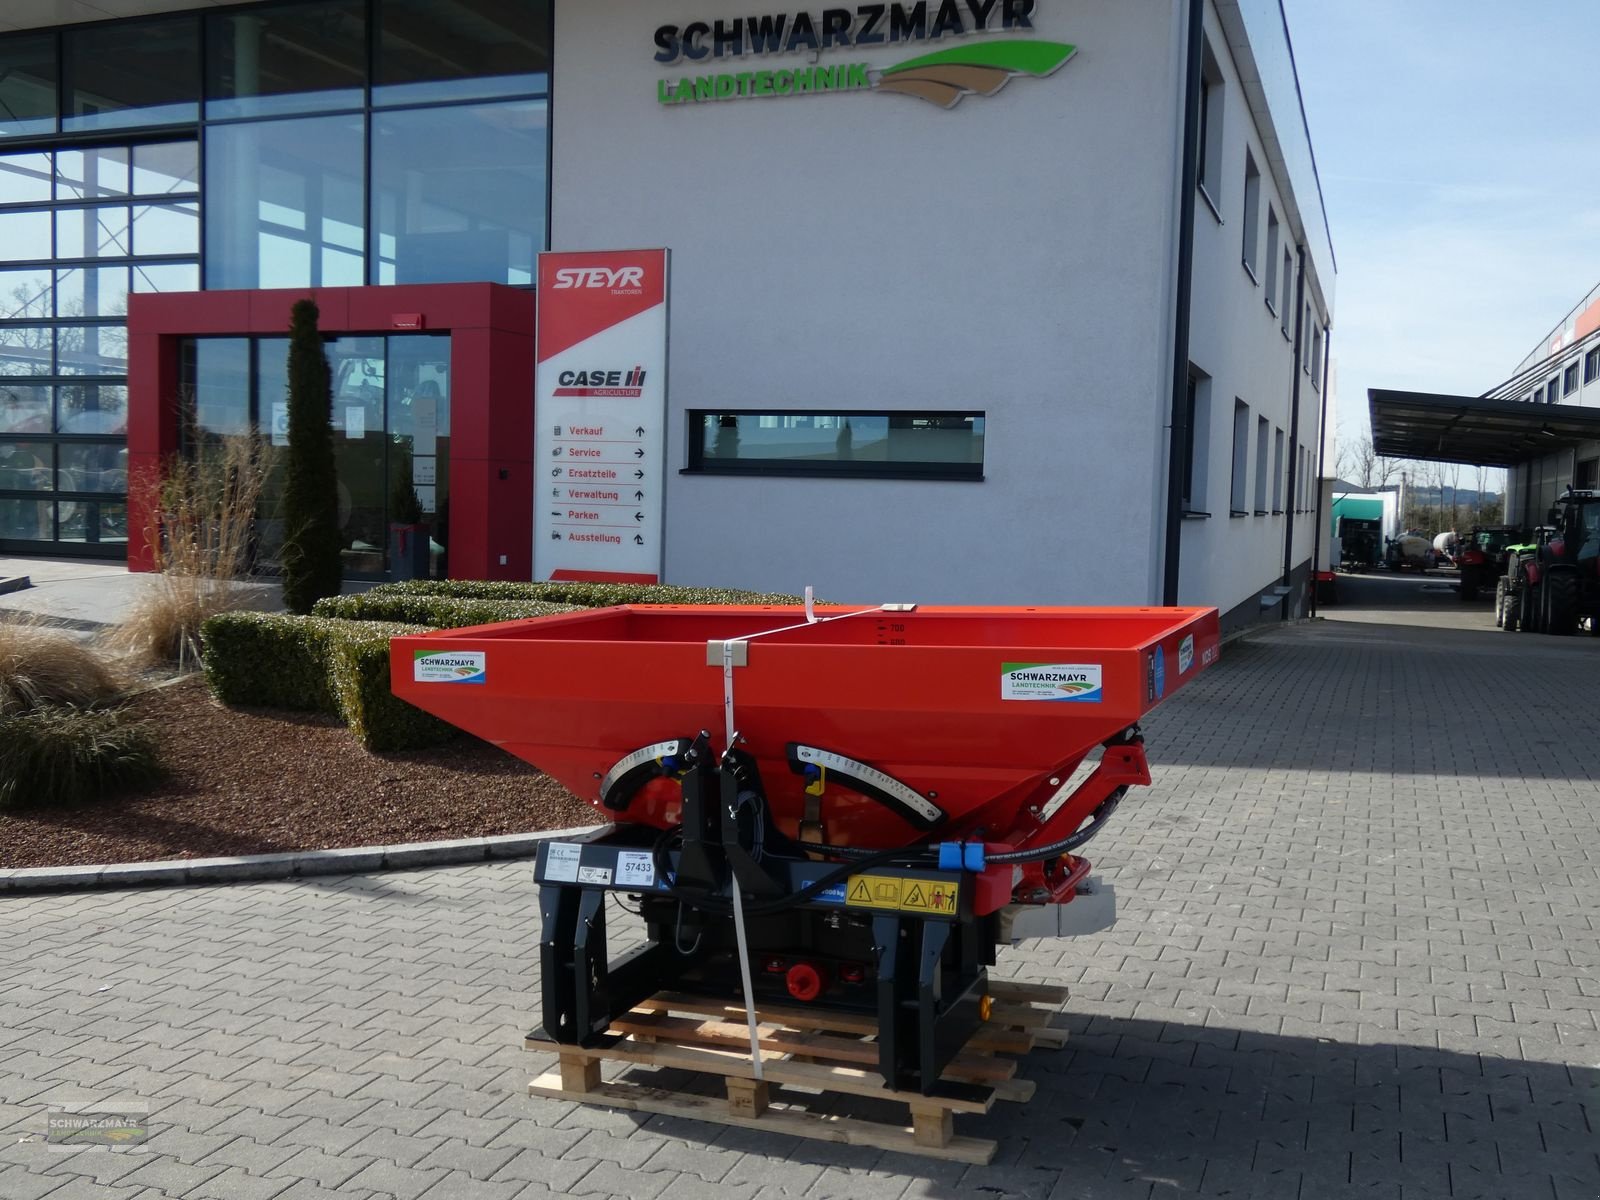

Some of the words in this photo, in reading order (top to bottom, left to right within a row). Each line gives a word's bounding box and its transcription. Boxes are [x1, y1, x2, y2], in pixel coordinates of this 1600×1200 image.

[653, 0, 1035, 64] SCHWARZMAYR
[657, 62, 871, 104] LANDTECHNIK
[552, 266, 645, 289] STEYR
[558, 370, 622, 387] CASE
[593, 389, 640, 397] AGRICULTURE
[569, 426, 604, 436] Verkauf
[569, 447, 601, 457] Service
[568, 468, 617, 479] Ersatzteile
[568, 489, 618, 501] Verwaltung
[568, 510, 599, 520] Parken
[568, 532, 621, 544] Ausstellung
[421, 659, 475, 667] SCHWARZMAYR
[1010, 672, 1087, 682] SCHWARZMAYR
[625, 862, 651, 872] 57433
